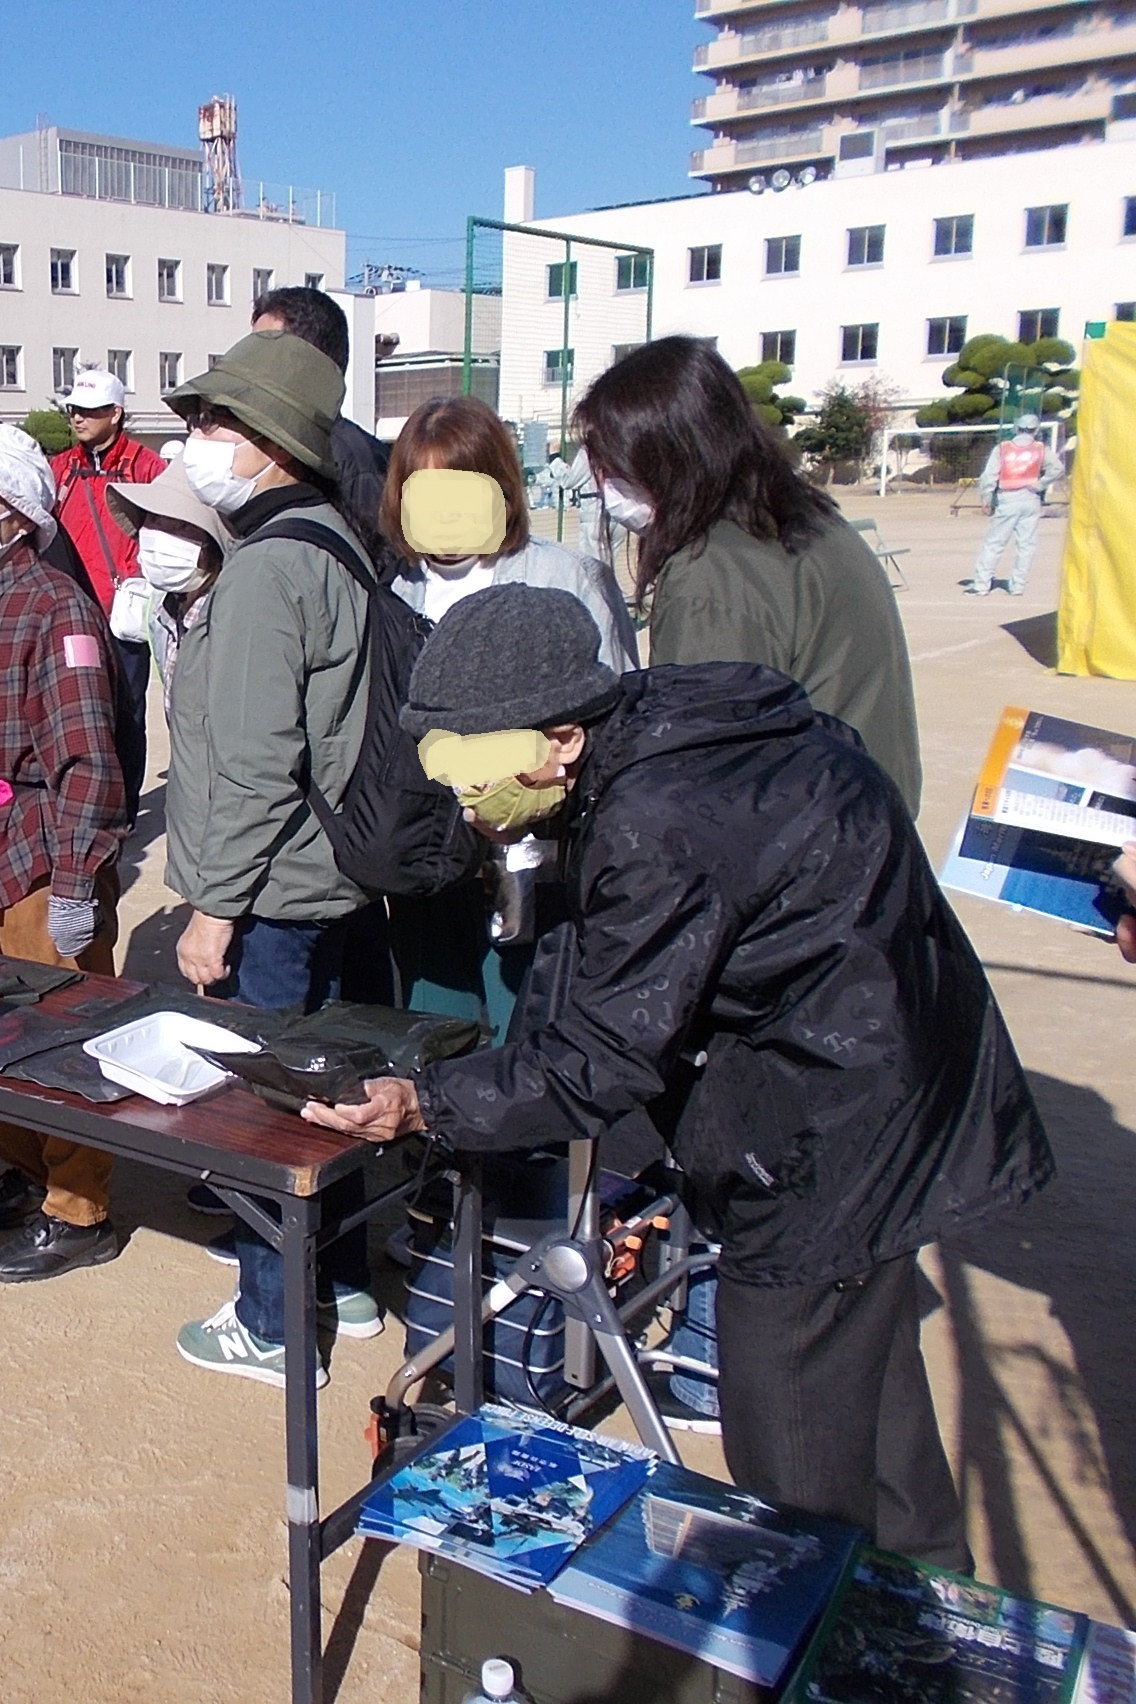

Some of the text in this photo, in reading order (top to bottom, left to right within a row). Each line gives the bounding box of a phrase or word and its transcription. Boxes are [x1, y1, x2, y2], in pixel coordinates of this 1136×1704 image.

[218, 1332, 248, 1361] N
[479, 1401, 658, 1459] JAPAN AIR SELF-DEFENSE FORCE
